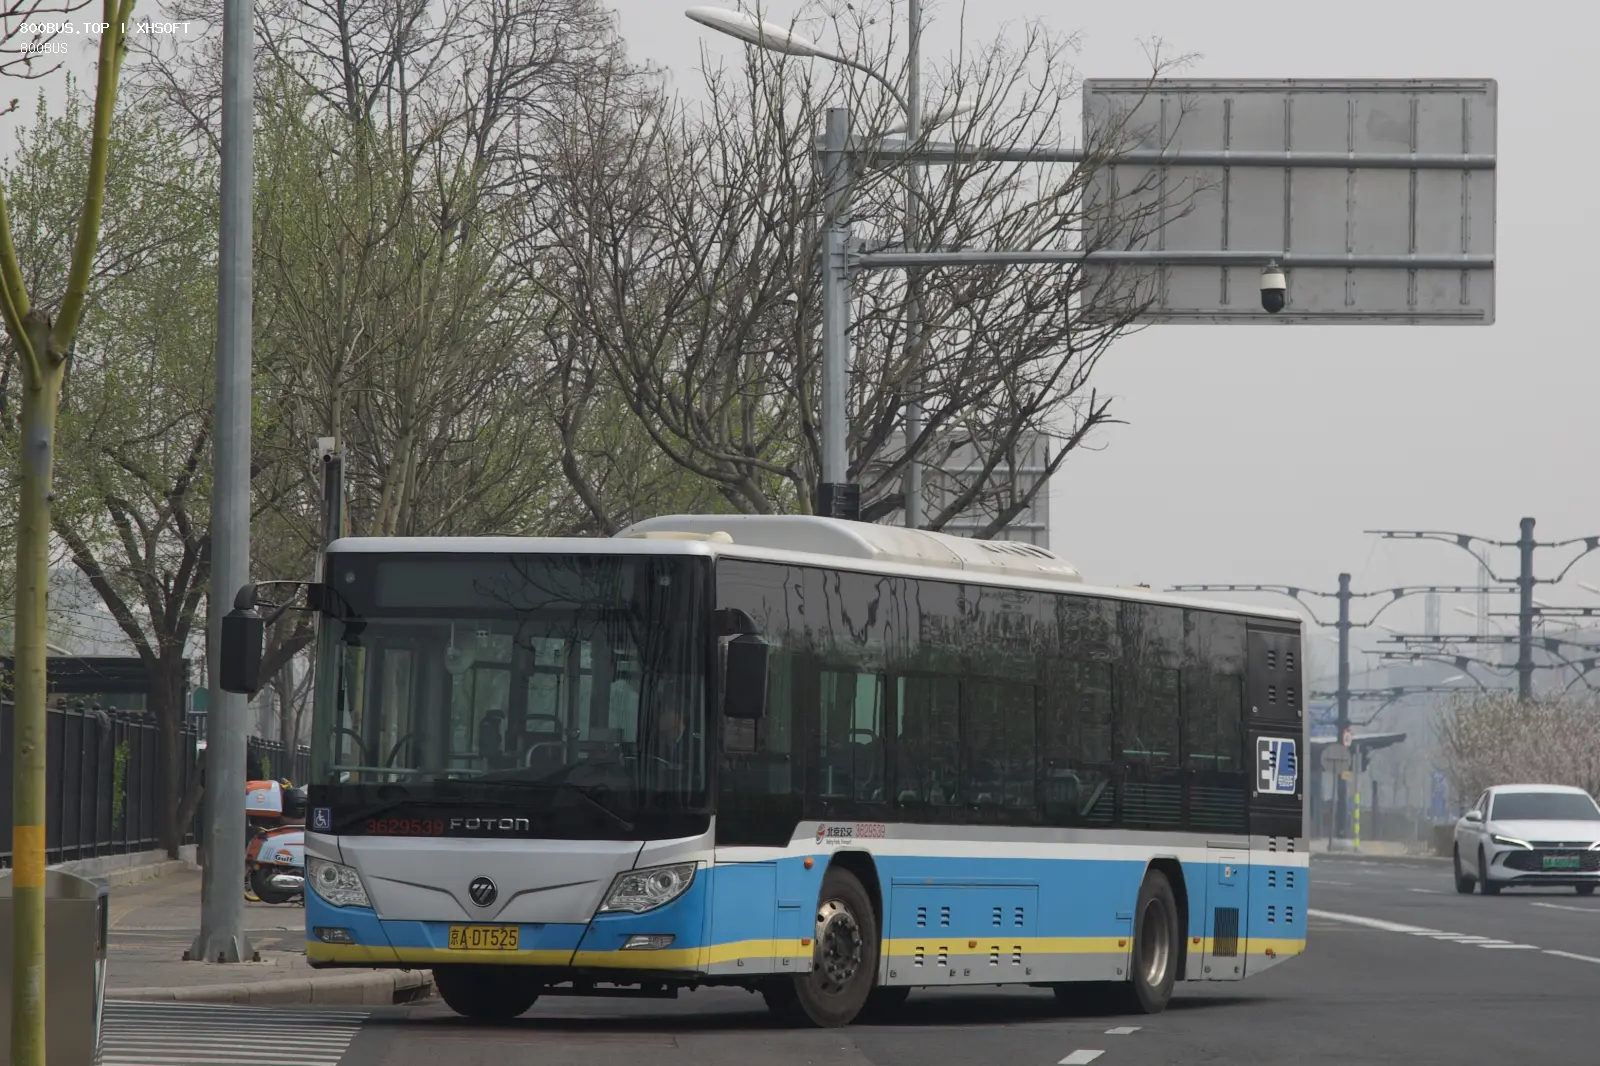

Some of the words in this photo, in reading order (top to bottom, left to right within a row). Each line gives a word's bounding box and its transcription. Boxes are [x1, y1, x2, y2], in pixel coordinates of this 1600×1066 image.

[365, 818, 444, 834] 3629539
[450, 817, 530, 831] FOTON
[856, 824, 885, 838] 3629539
[826, 826, 853, 837] 北京公交
[274, 853, 293, 863] Gulf
